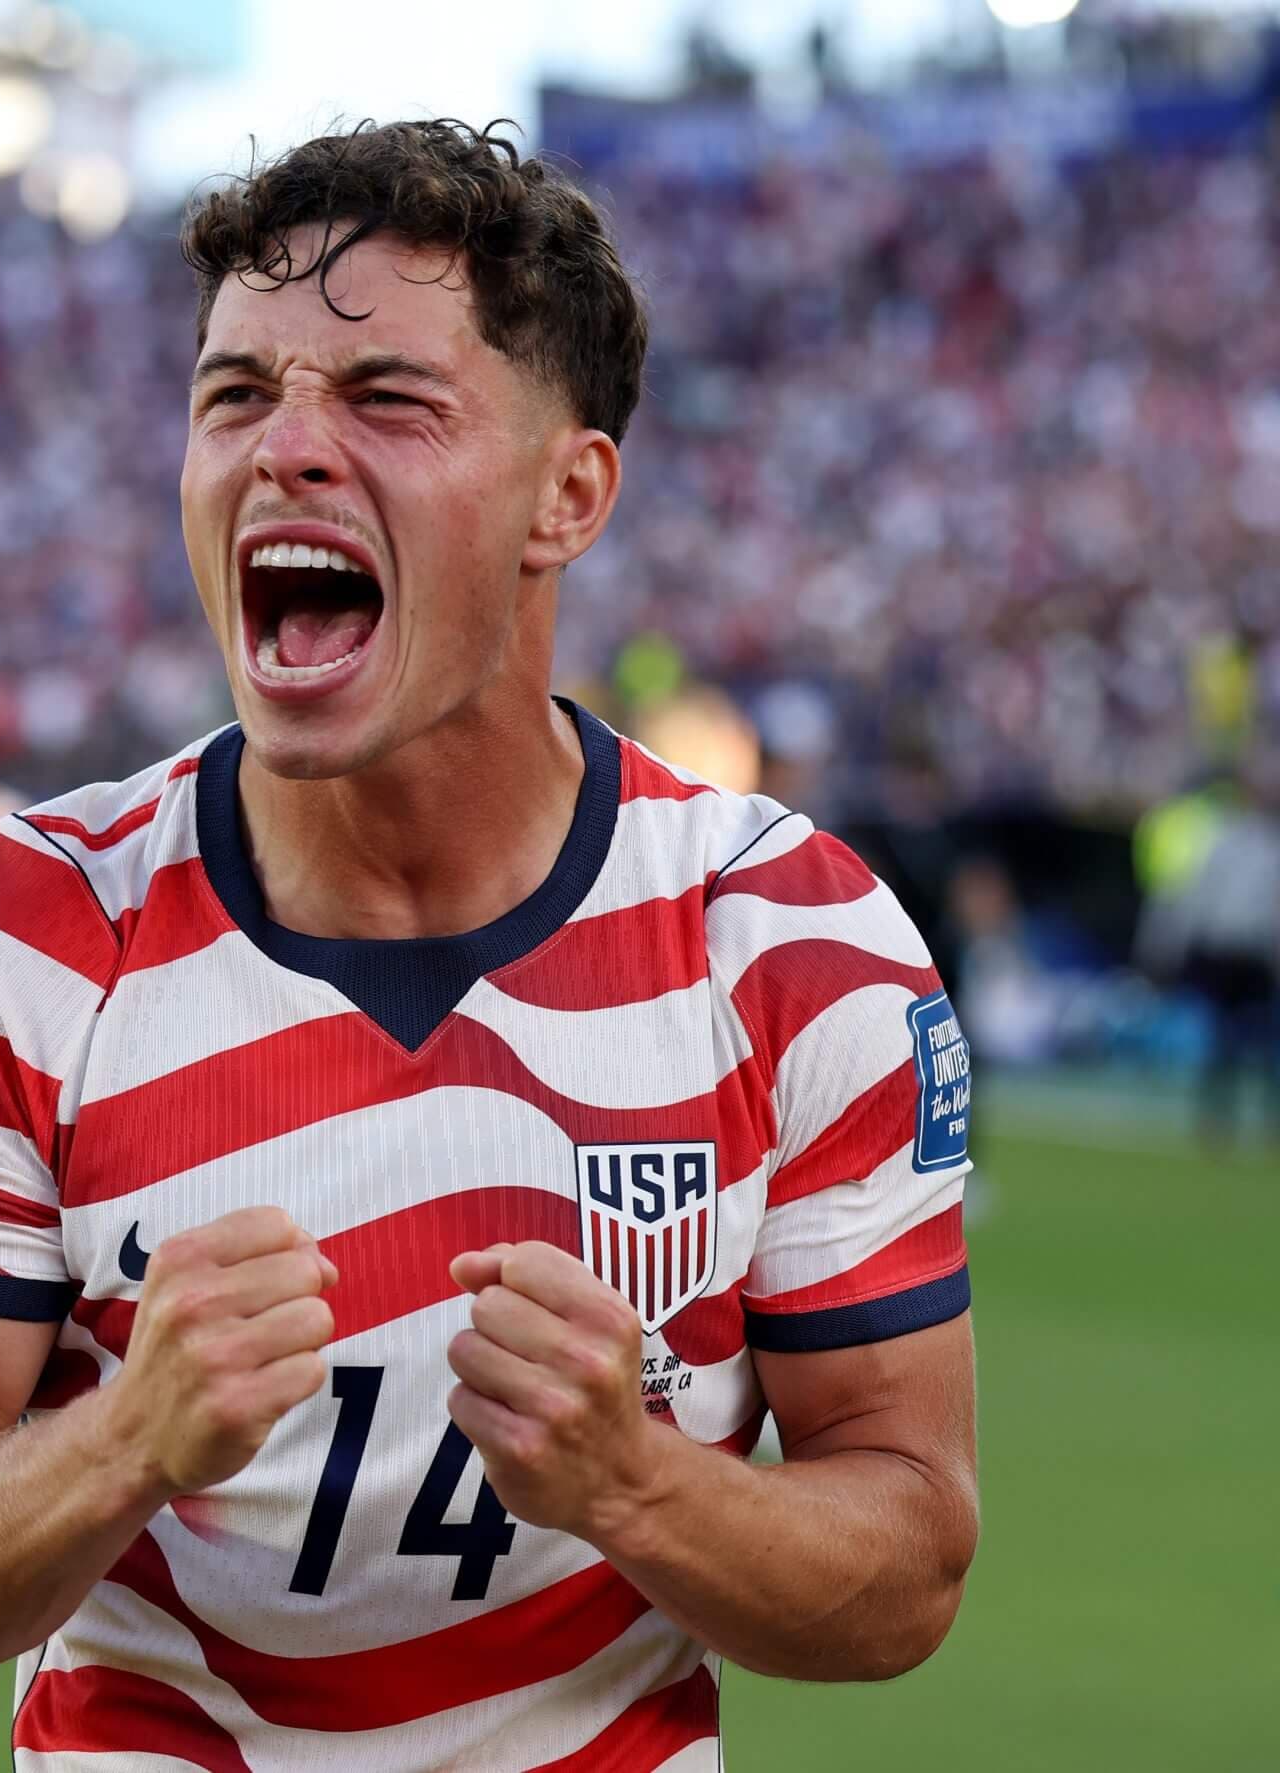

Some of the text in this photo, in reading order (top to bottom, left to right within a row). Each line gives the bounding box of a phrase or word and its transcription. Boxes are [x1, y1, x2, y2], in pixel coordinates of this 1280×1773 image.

[932, 1040, 969, 1088] UNITES
[930, 1089, 952, 1122] the
[587, 1152, 708, 1224] USA
[662, 1352, 682, 1373] BIH
[640, 1371, 692, 1396] LARA, CA
[288, 1366, 517, 1601] 14
